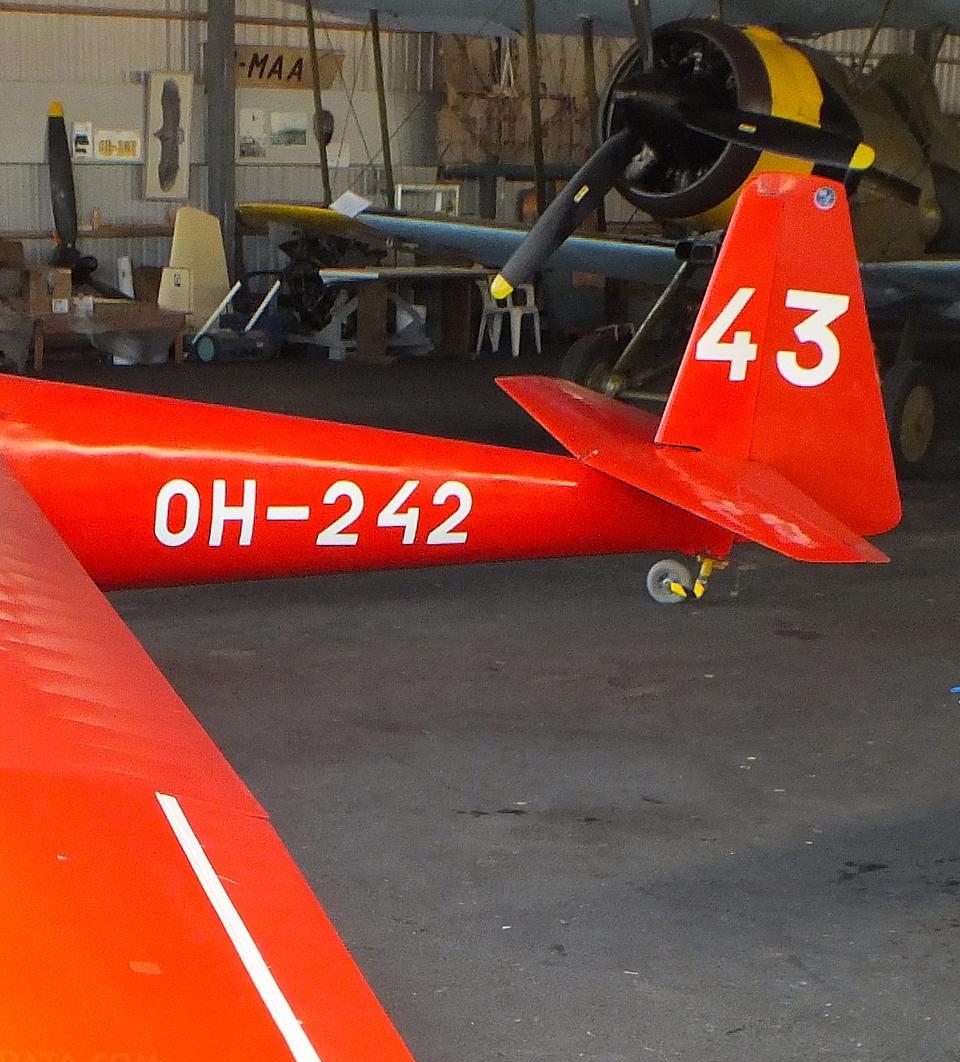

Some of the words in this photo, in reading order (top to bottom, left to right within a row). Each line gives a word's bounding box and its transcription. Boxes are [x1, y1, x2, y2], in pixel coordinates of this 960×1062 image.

[233, 50, 305, 81] -MAA
[695, 287, 851, 388] 43
[154, 478, 474, 547] OH-242
